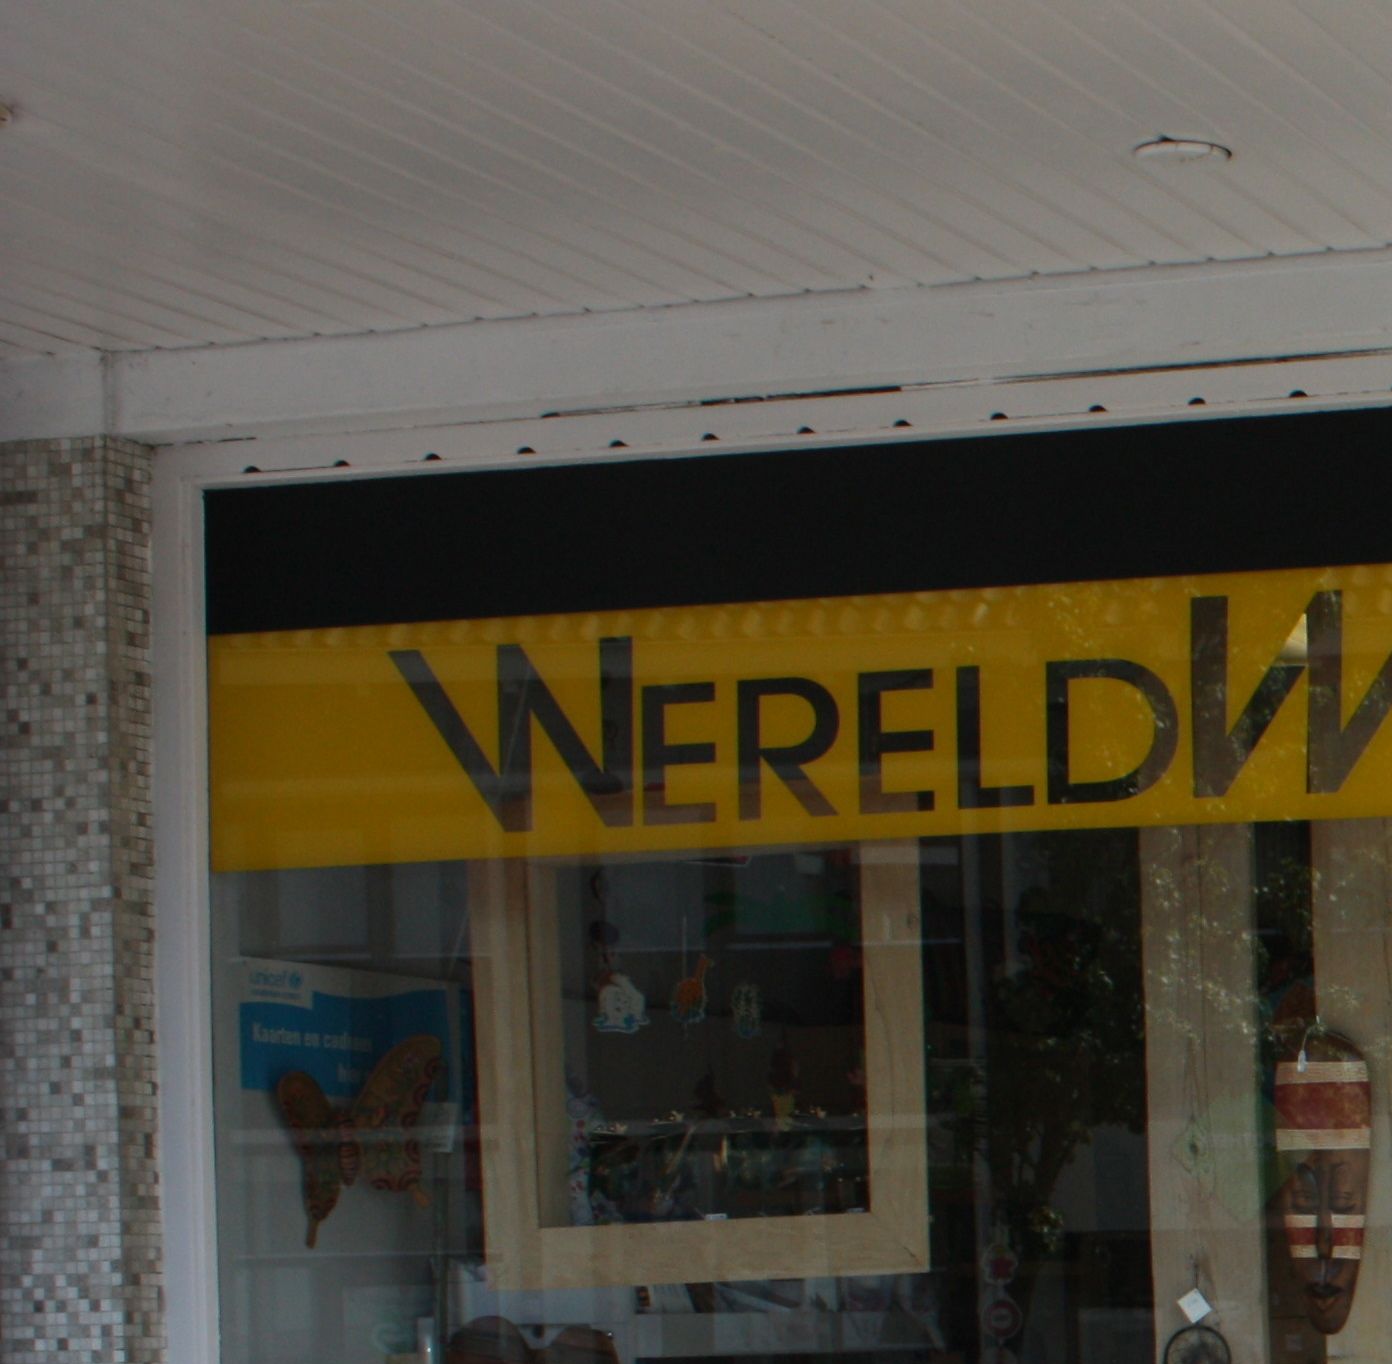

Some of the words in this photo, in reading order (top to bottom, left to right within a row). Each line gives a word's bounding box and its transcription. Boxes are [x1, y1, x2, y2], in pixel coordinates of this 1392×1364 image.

[249, 969, 288, 986] unicef
[252, 1022, 302, 1047] Kaarten
[304, 1032, 320, 1048] en
